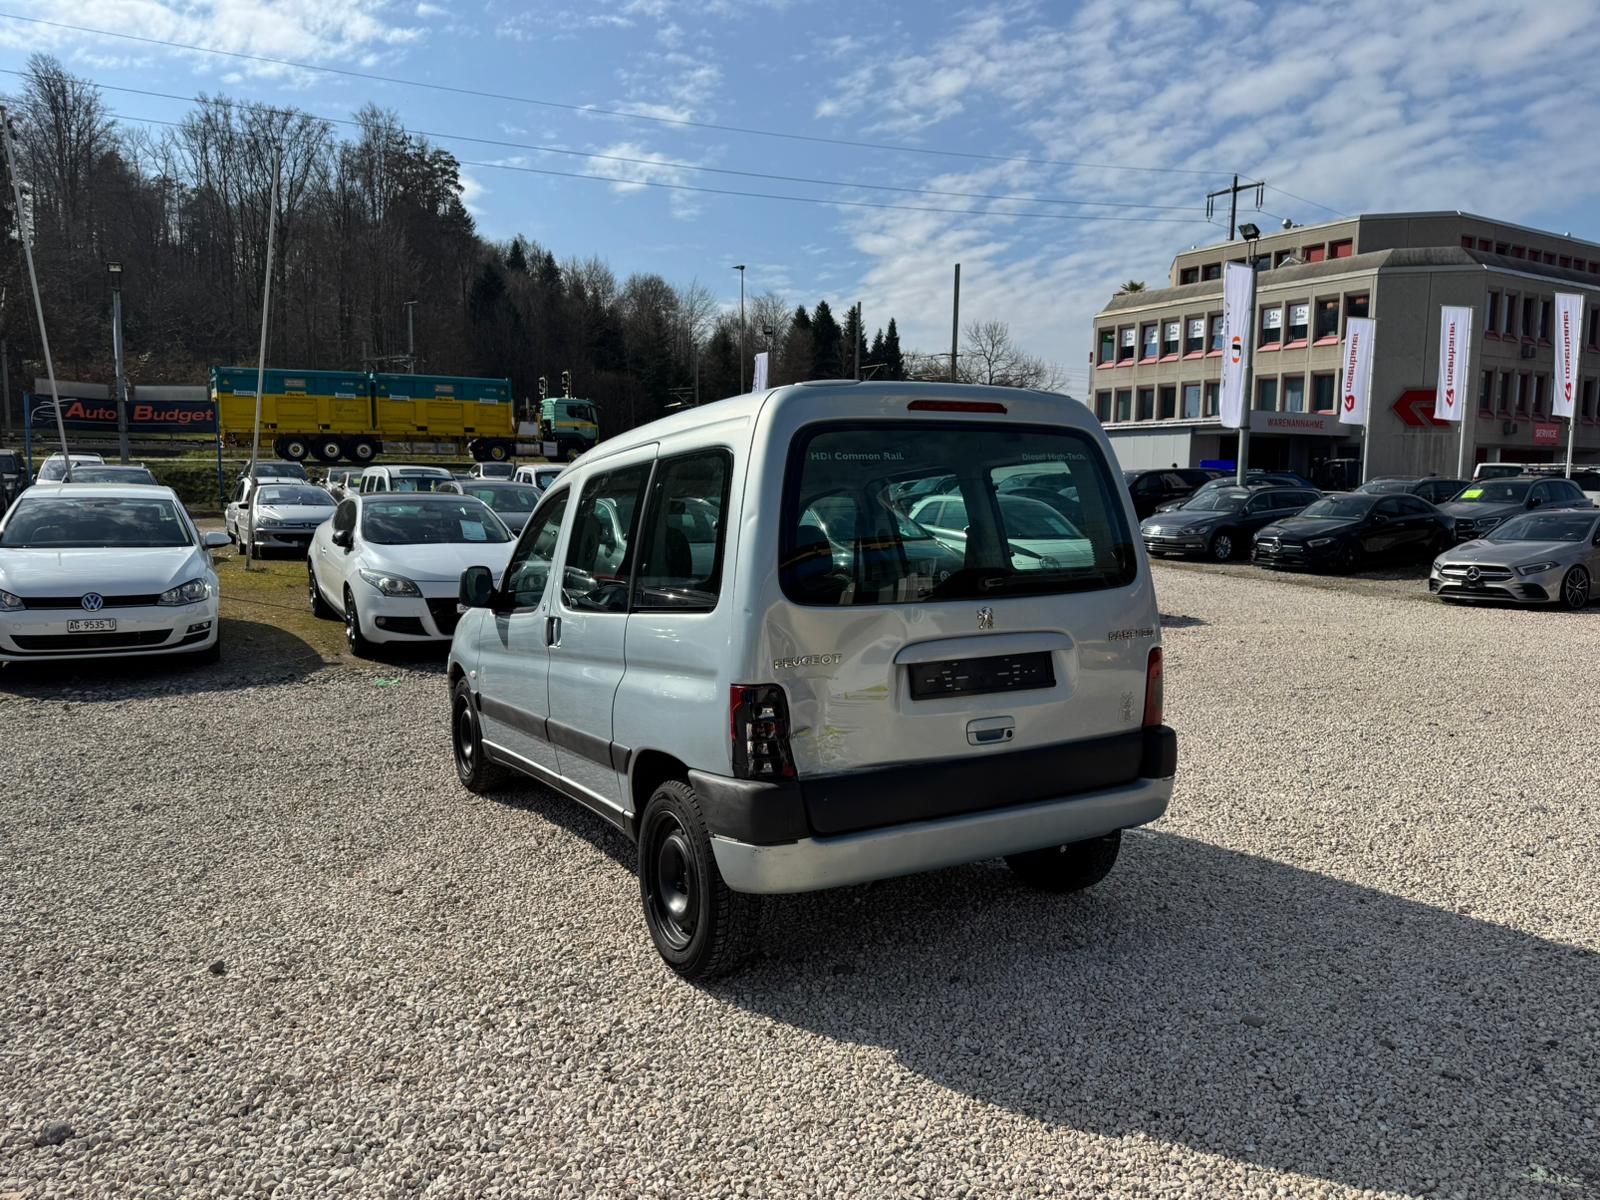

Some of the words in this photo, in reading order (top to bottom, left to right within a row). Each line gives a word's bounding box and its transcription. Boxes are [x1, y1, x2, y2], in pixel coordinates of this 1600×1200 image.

[65, 402, 116, 420] Auto
[133, 405, 214, 425] Budget
[1267, 418, 1324, 429] WARENANNAHME
[1536, 429, 1557, 438] SERVICE
[834, 452, 880, 461] Common
[773, 653, 843, 670] PEUGEOT
